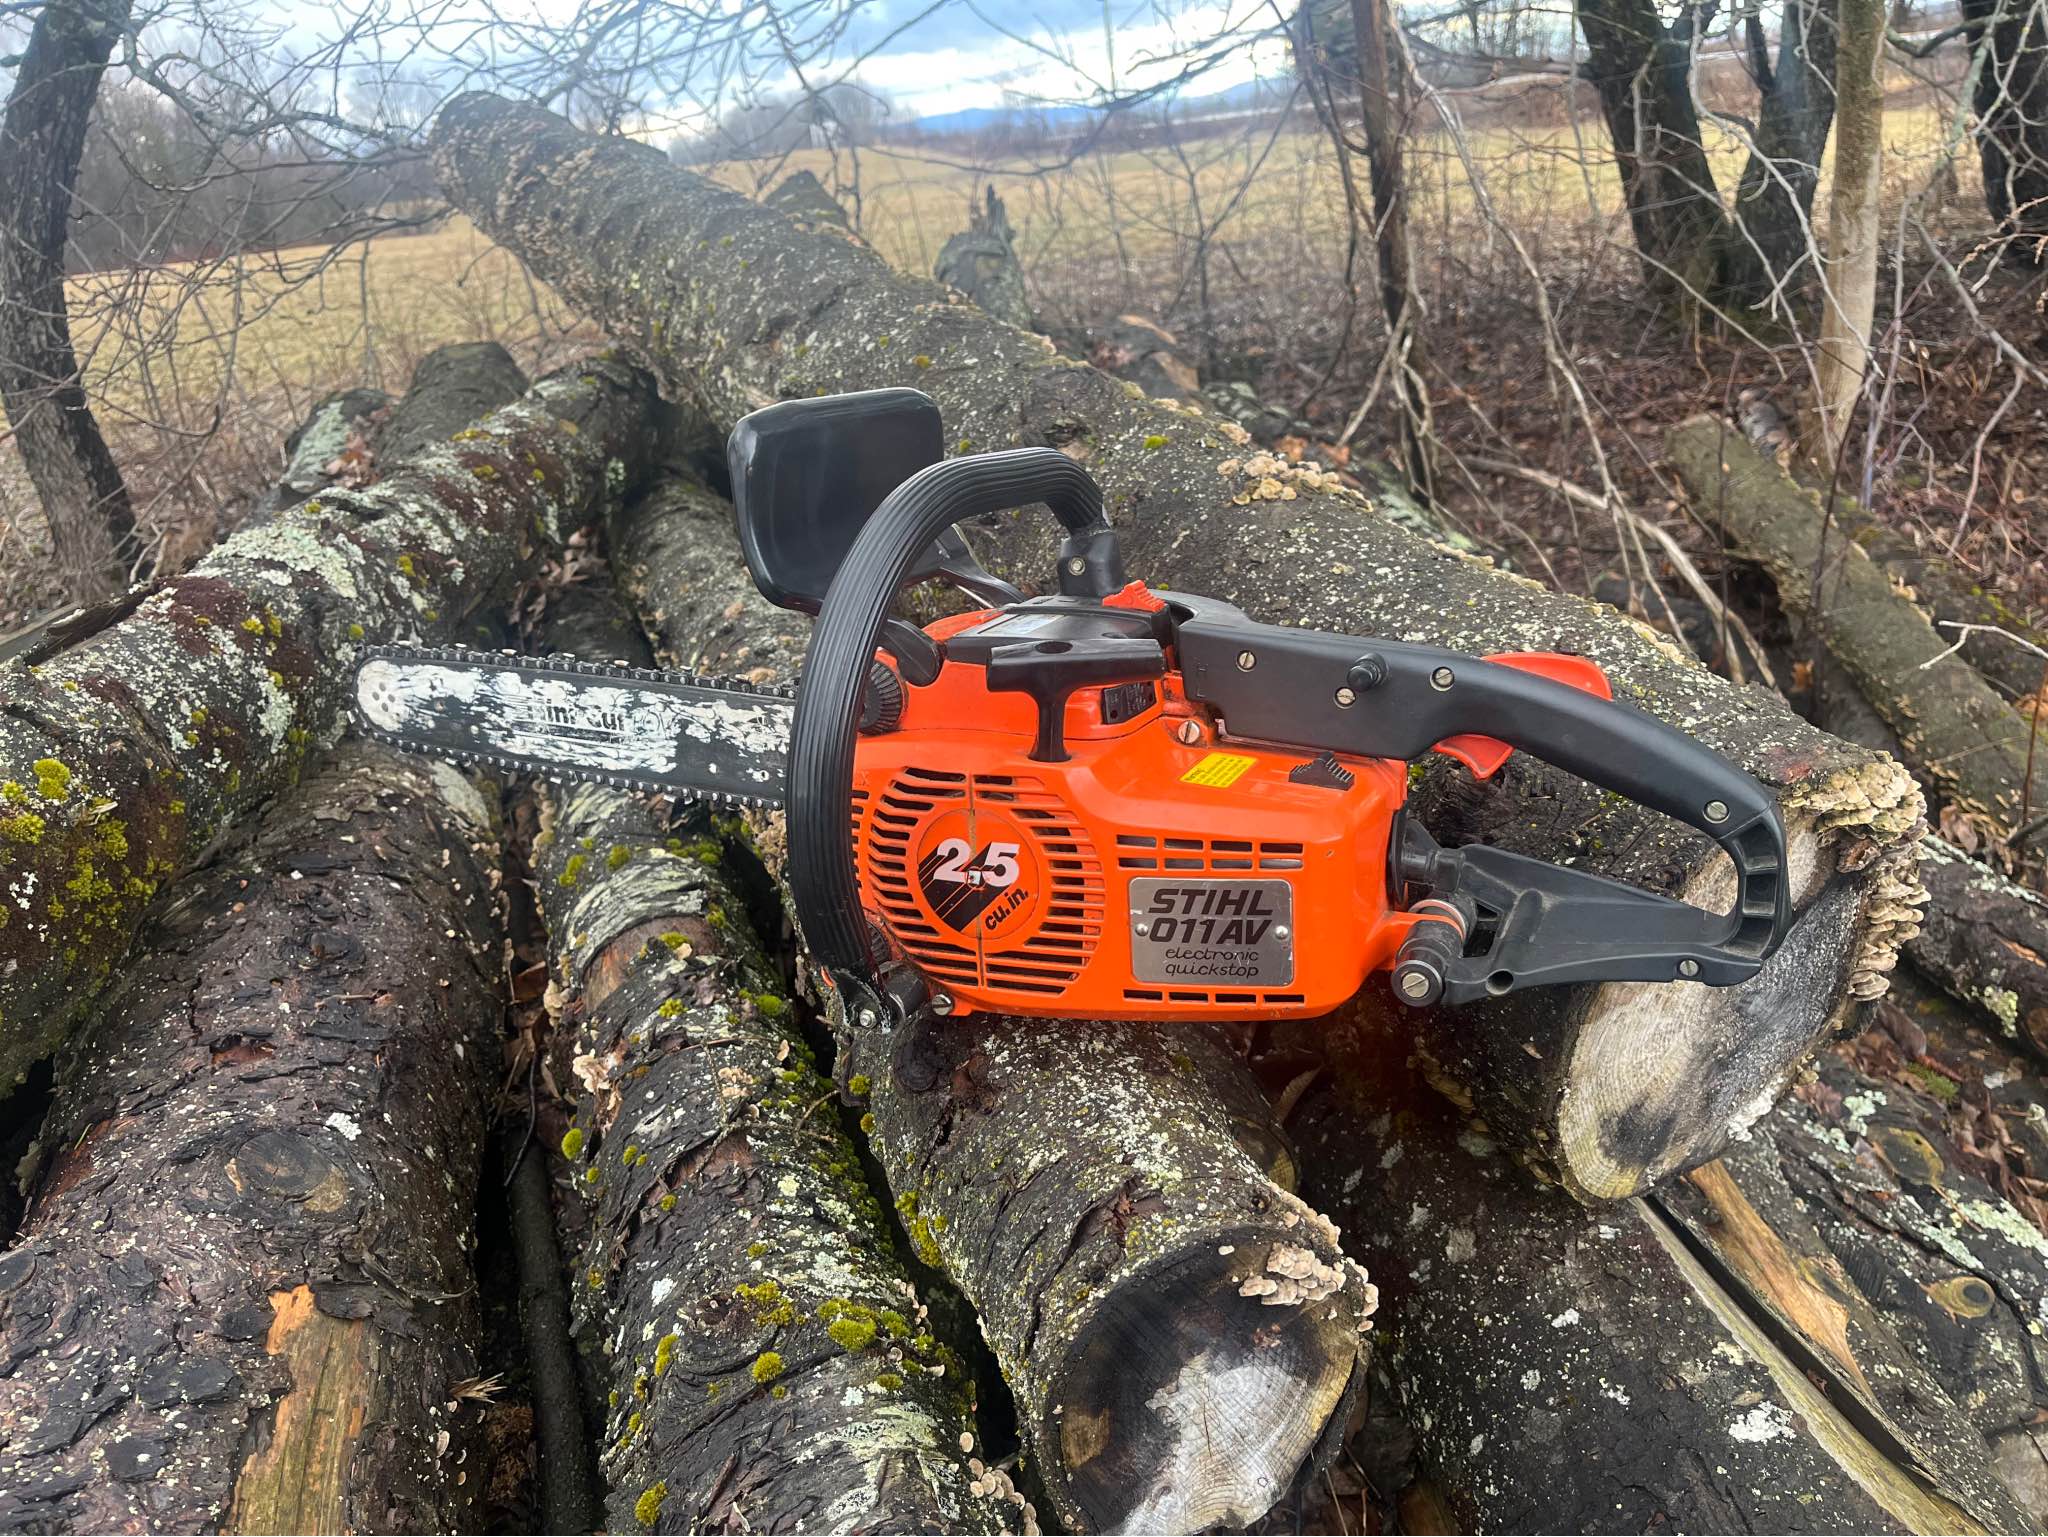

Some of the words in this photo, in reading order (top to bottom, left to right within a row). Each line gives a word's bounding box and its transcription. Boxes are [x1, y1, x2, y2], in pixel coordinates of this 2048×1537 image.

[933, 838, 1020, 887] 2.5
[1148, 888, 1273, 916] STIHL
[1165, 948, 1259, 961] electronic
[1165, 962, 1259, 979] quickstop
